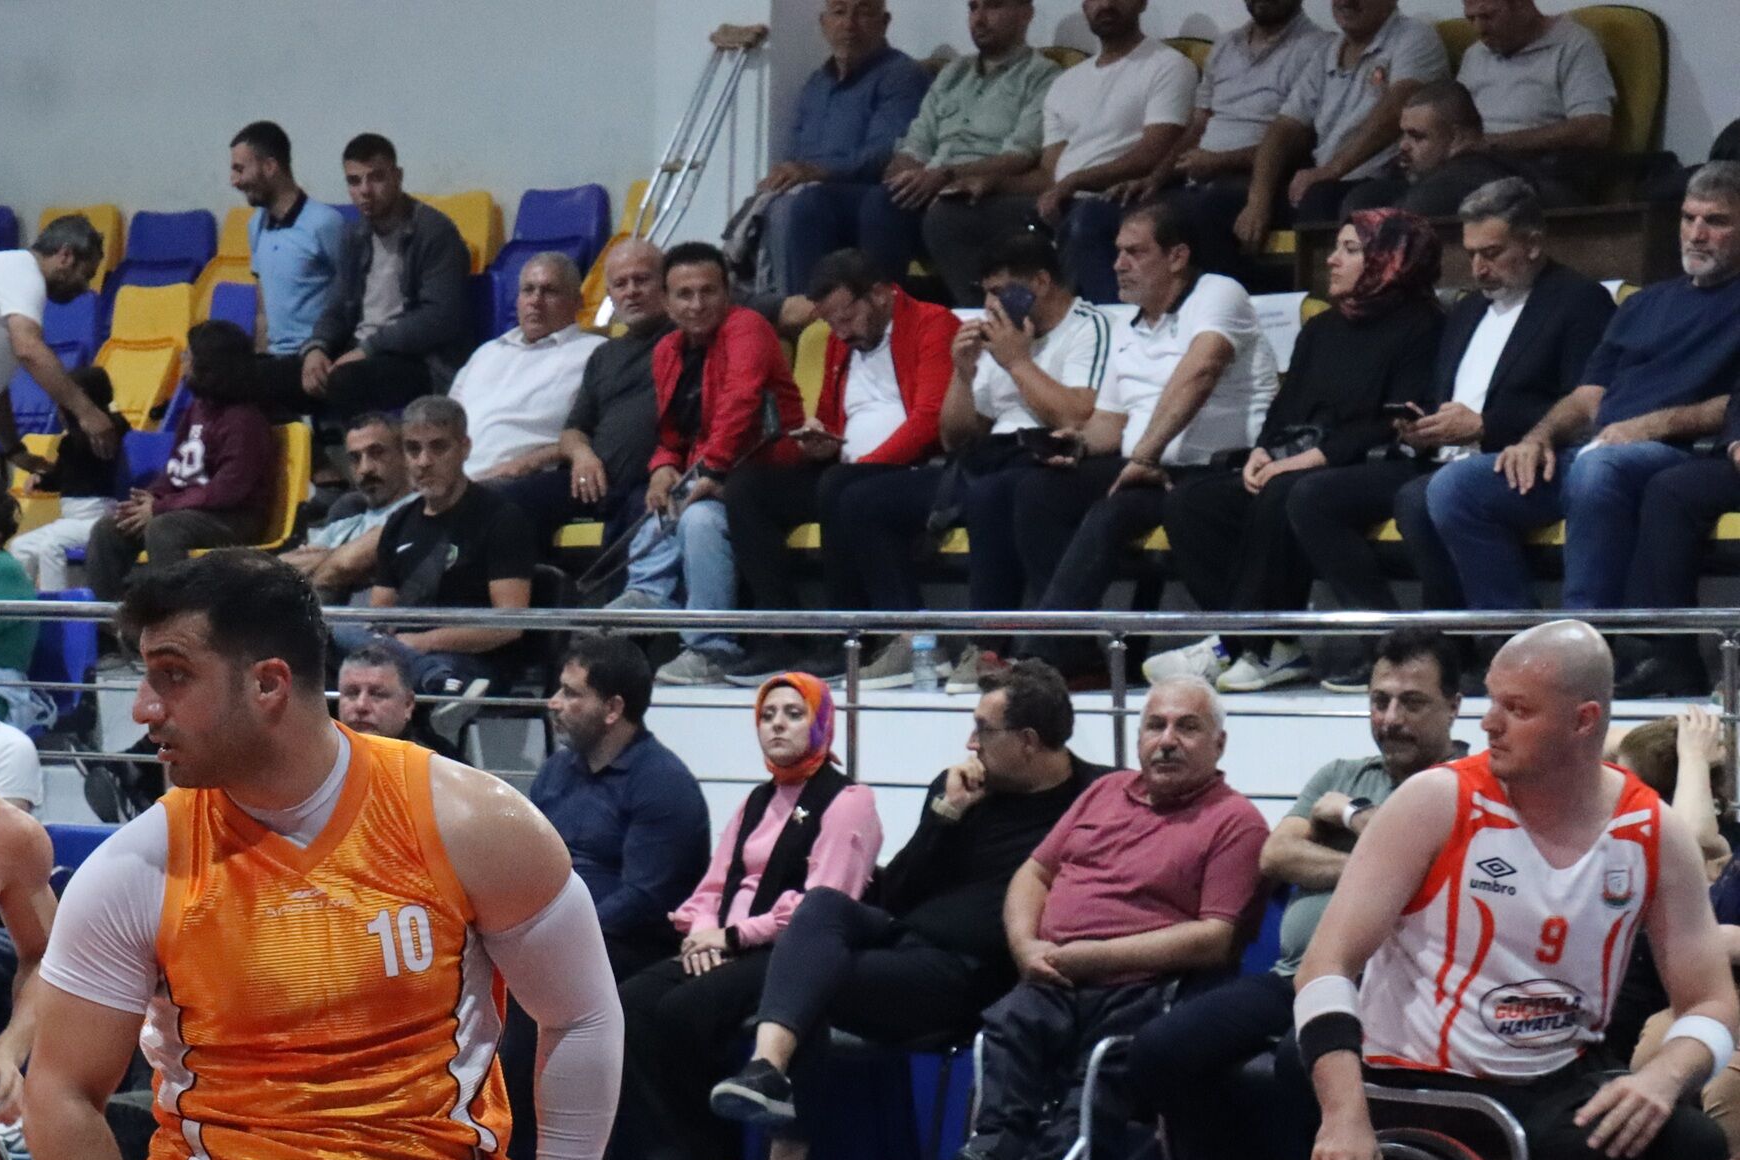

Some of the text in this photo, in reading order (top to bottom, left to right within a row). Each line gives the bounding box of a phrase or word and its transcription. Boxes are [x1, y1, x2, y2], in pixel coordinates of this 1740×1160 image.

[1469, 878, 1517, 896] umbro
[366, 904, 434, 978] 10
[1535, 915, 1569, 965] 9
